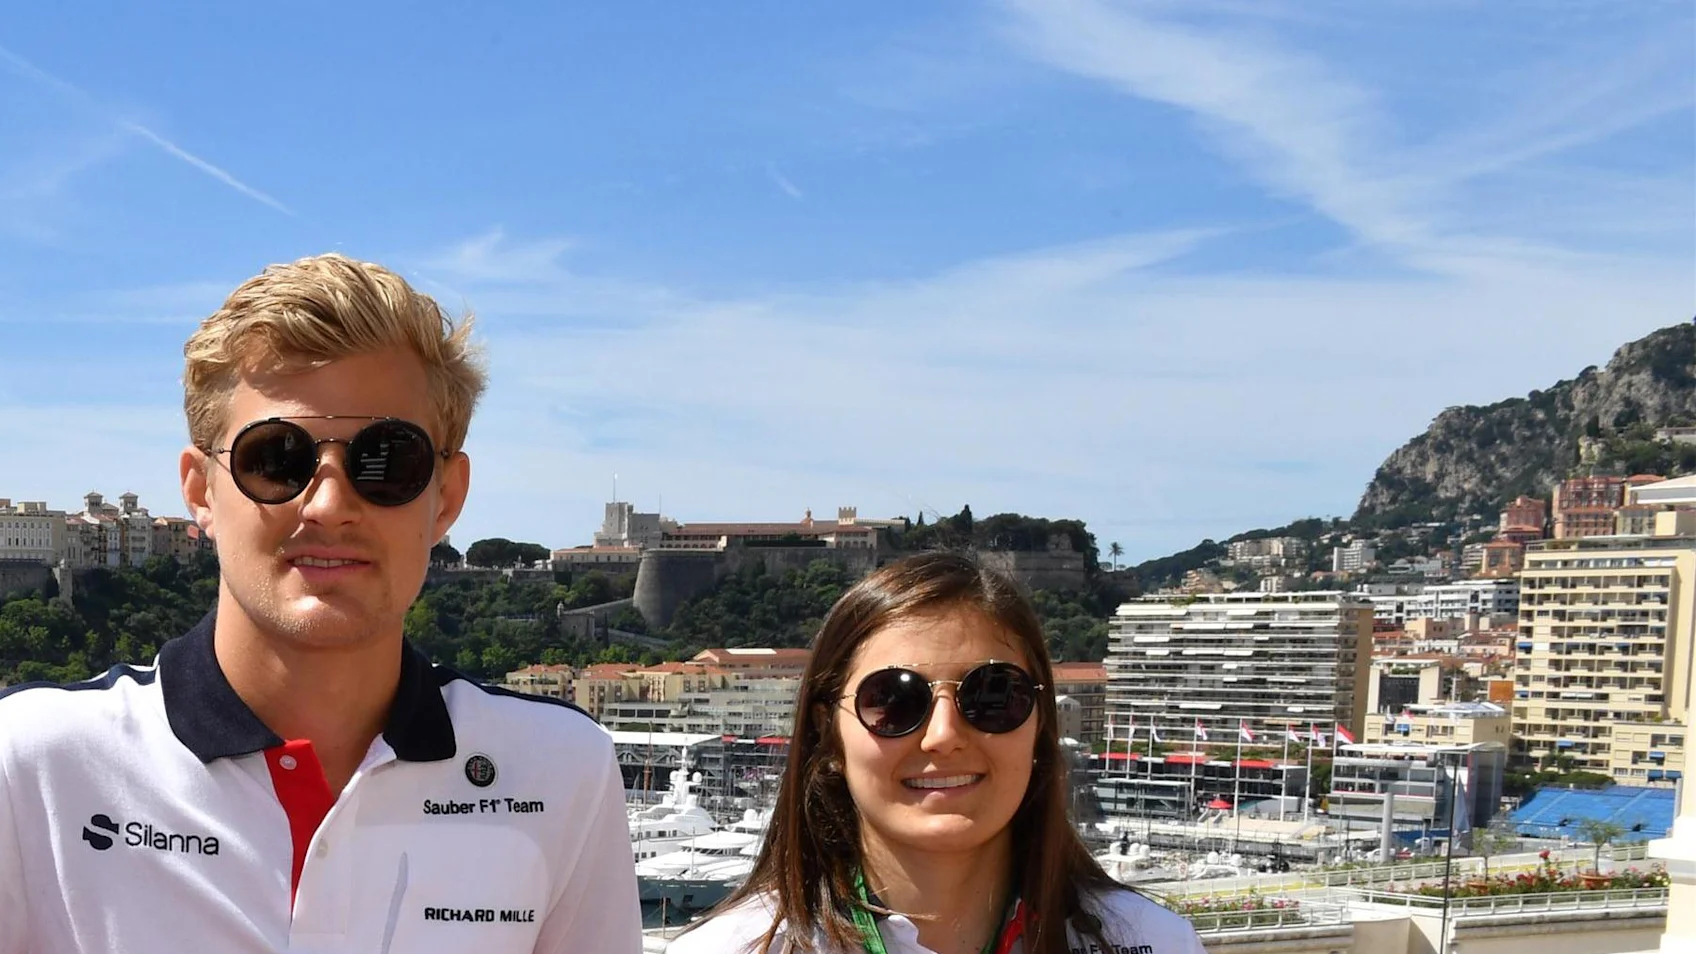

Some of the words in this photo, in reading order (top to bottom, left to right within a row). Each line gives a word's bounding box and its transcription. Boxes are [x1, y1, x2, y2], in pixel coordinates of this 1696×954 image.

[423, 799, 476, 815] Sauber
[504, 798, 544, 813] Team
[125, 821, 220, 856] Silanna
[424, 907, 495, 922] RICHARD
[500, 909, 535, 923] MILLE
